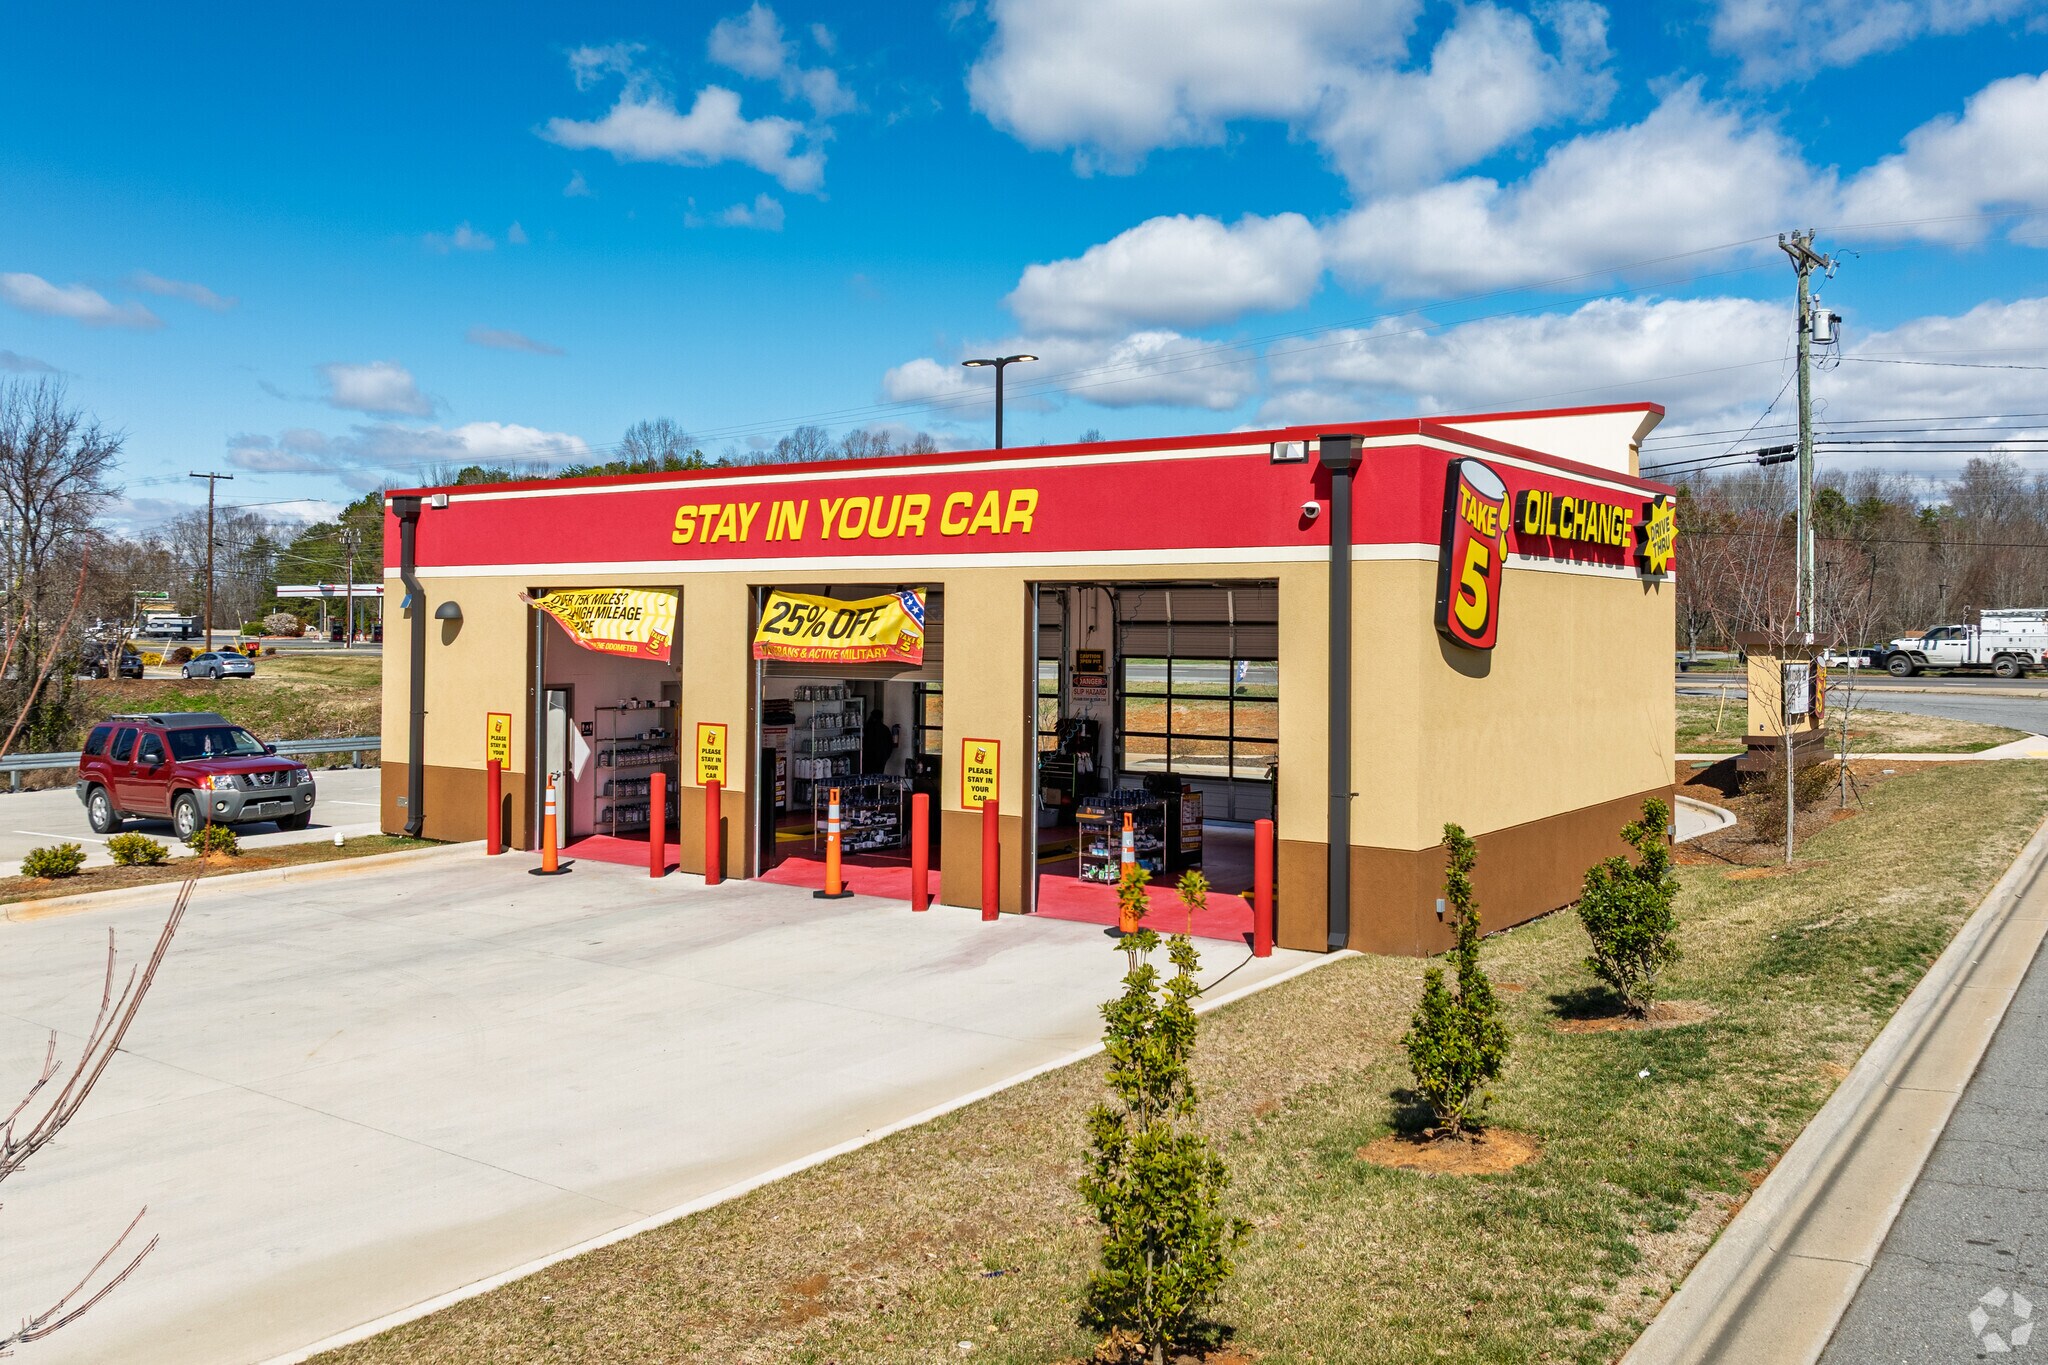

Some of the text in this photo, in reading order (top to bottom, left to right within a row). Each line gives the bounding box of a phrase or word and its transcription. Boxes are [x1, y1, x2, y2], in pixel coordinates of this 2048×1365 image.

[671, 488, 1039, 544] STAY IN YOUR CAR
[1460, 484, 1498, 539] TAKE
[1524, 489, 1633, 548] OIL CHANGE
[1651, 516, 1670, 541] DRIVE
[1653, 534, 1670, 558] THRU
[1454, 537, 1490, 634] 5
[575, 594, 593, 605] 75K
[591, 593, 629, 606] MILES?
[594, 606, 643, 621] MILEAGE
[762, 601, 889, 640] 25% OFF
[605, 643, 638, 653] ODOMETER
[650, 640, 660, 650] 5
[800, 648, 807, 658] &
[808, 648, 840, 660] ACTIVE
[840, 647, 889, 660] MILITARY
[900, 641, 911, 652] 5
[968, 767, 993, 775] PLEASE
